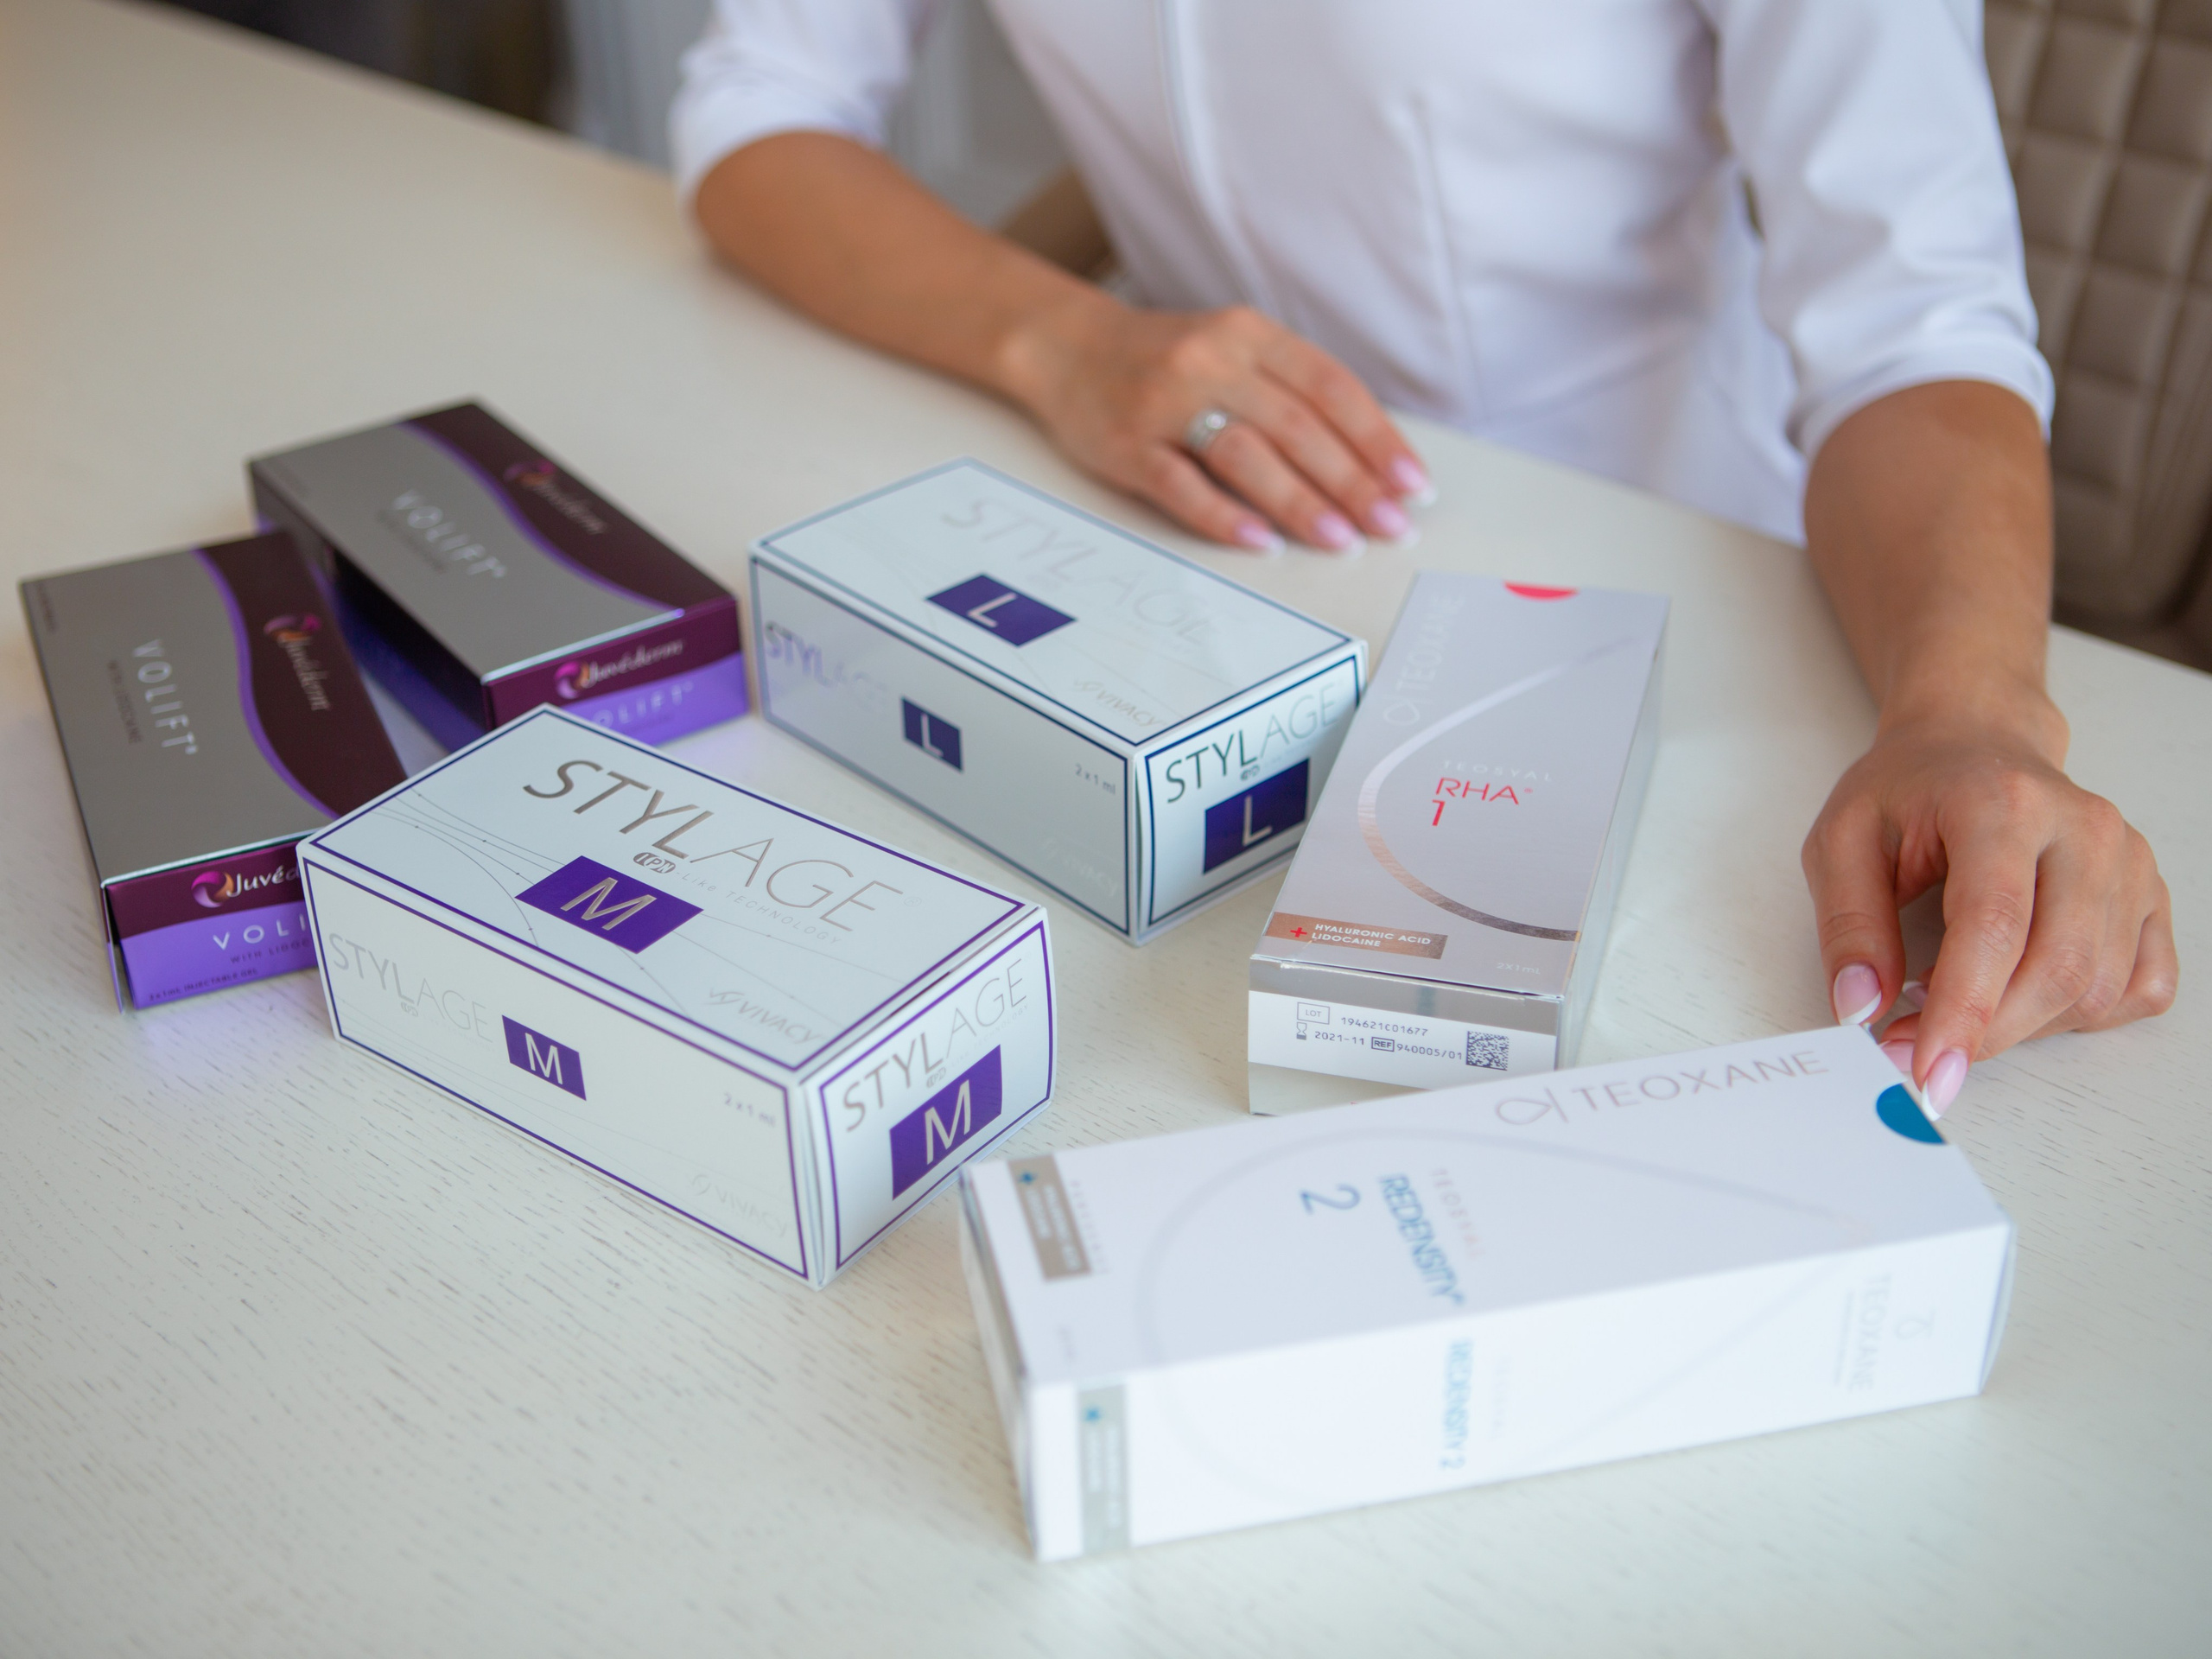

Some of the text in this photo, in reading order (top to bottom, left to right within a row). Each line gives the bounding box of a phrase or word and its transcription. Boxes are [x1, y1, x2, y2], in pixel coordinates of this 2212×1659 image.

[967, 593, 1018, 628] L
[921, 713, 945, 757] L
[1242, 795, 1273, 847] L
[1431, 798, 1446, 827] 1
[559, 876, 658, 931] M
[726, 890, 842, 945] TECHNOLOGY
[1311, 931, 1382, 949] LIDOCAINE
[1314, 923, 1432, 946] HYALURONIC ACID
[328, 931, 493, 1044] STYLAGE
[1305, 1008, 1322, 1019] LOT
[1341, 1016, 1429, 1037] 194621C01677
[524, 1032, 563, 1085] M
[1313, 1030, 1463, 1061] 2021-11 REF 940005/01
[722, 1090, 733, 1107] 2
[1571, 1050, 1830, 1114] TEOXANE
[924, 1078, 972, 1166] M
[1299, 1181, 1362, 1215] 2
